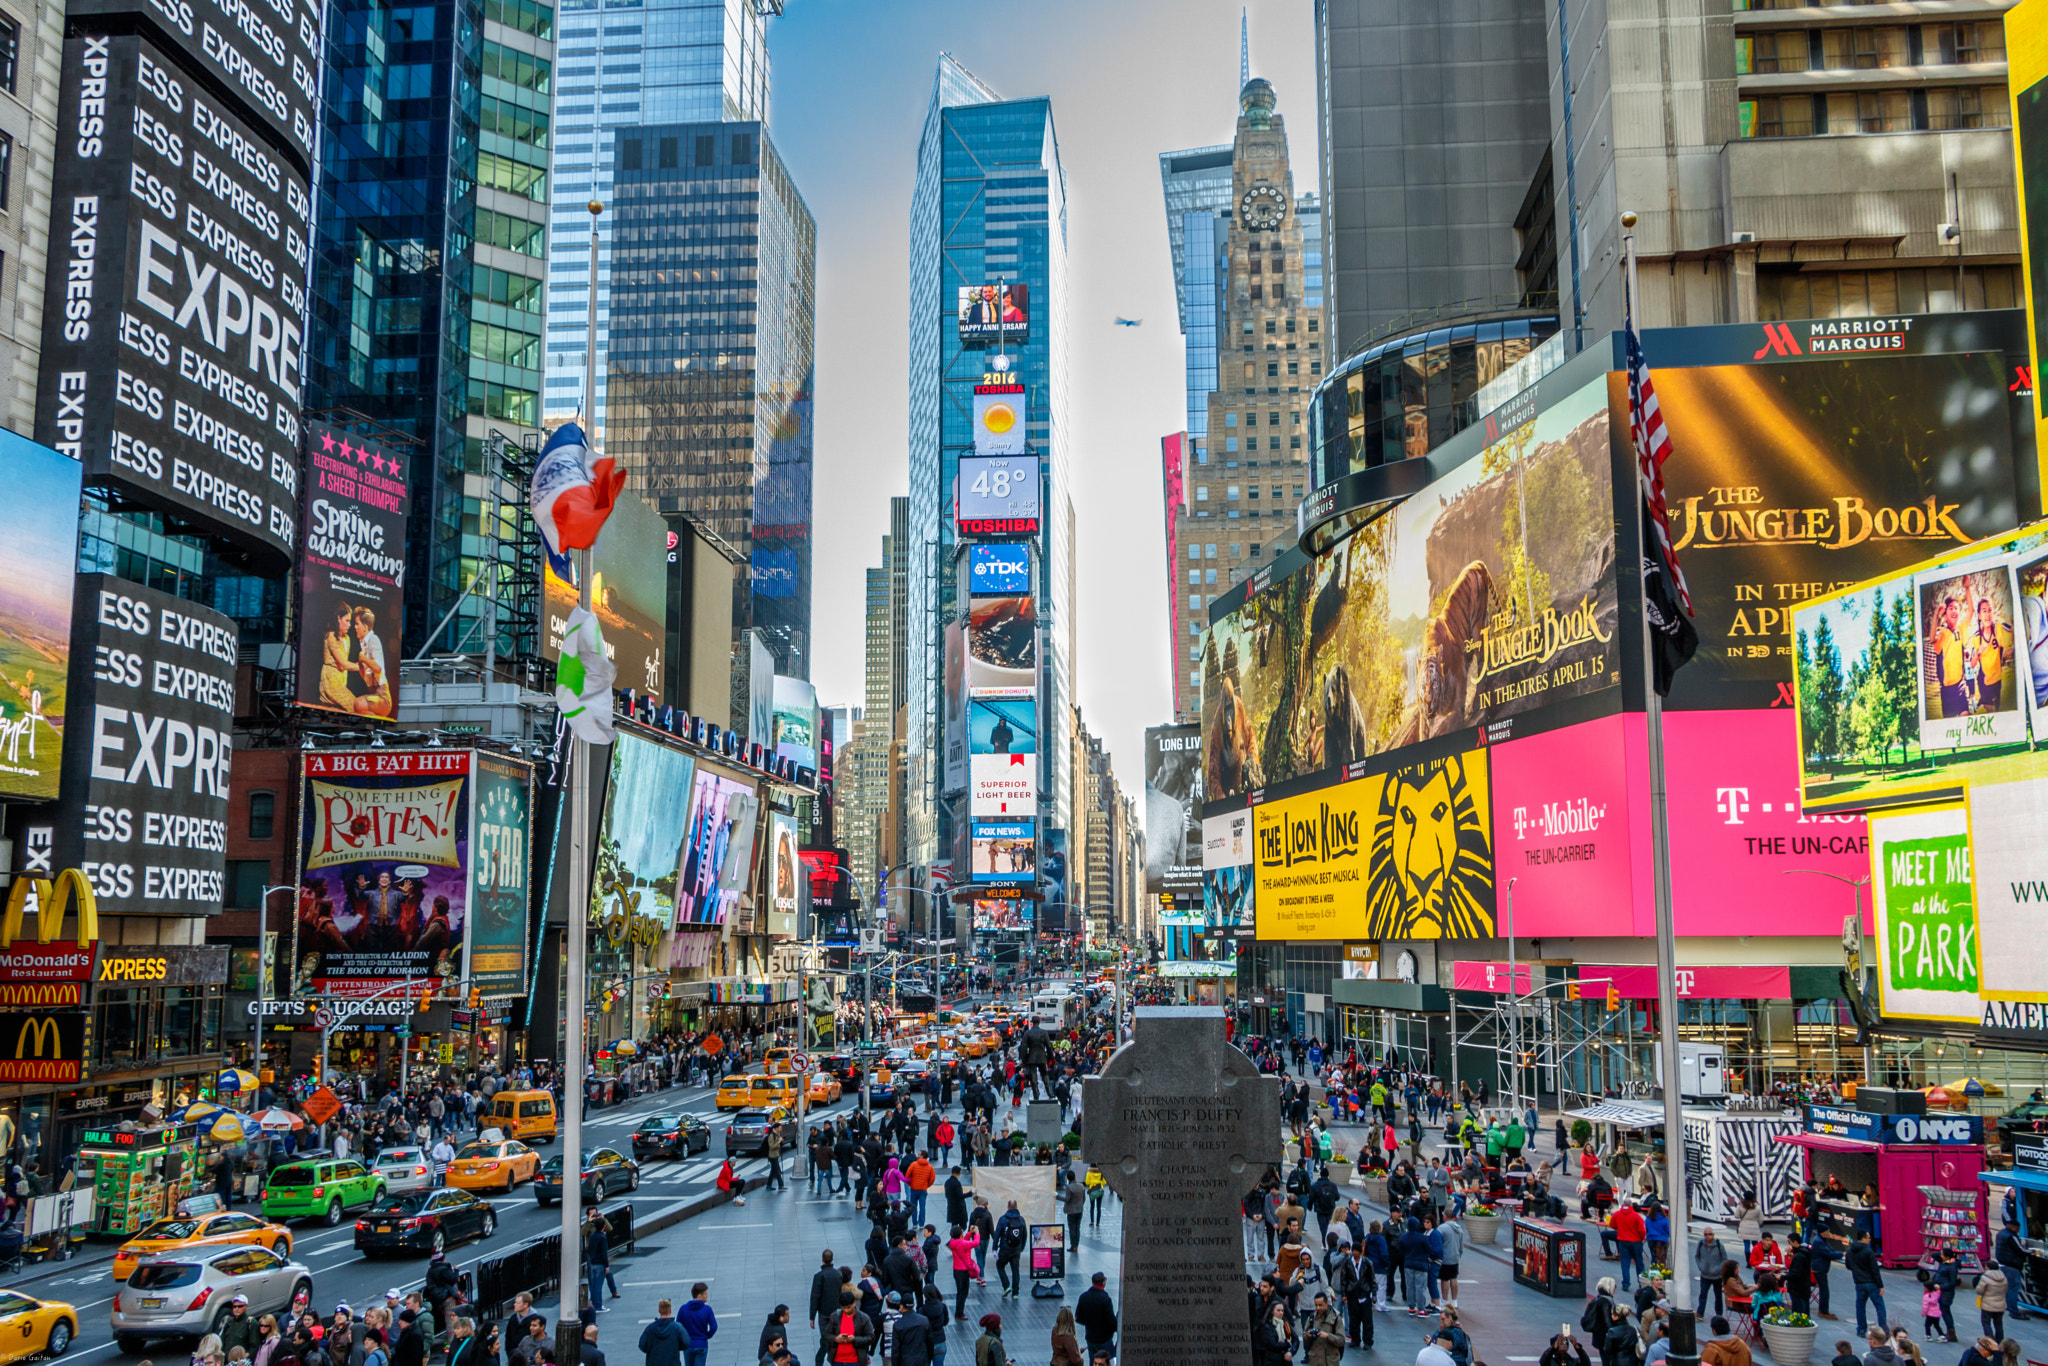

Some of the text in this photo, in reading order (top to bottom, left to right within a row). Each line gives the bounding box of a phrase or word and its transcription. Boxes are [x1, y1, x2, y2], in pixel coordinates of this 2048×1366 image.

[202, 21, 288, 121] EXPRESS
[137, 53, 280, 193] ESS EXPRESS
[63, 36, 109, 342] XPRESS EXPRESS
[191, 150, 281, 241] EXPRESS
[130, 162, 275, 290] ESS EXPRESS
[960, 322, 1028, 332] HAPPY ANNIERSARY
[1811, 318, 1913, 336] MARRIOTT
[1811, 335, 1902, 352] MARQUIS
[179, 345, 269, 422] EXPRESS
[983, 372, 1016, 385] 2016
[974, 385, 1025, 395] TOSHIBA
[1501, 386, 1539, 418] MARRIOTT
[116, 369, 264, 472] ESS EXPRESS
[1501, 402, 1536, 433] MARQUIS
[988, 442, 1012, 450] Sunny
[989, 459, 1010, 467] Now
[172, 457, 263, 526] EXPRESS
[319, 470, 326, 489] A
[327, 474, 355, 499] SHEER
[970, 469, 1027, 498] 48°
[1708, 486, 1764, 506] THE
[960, 518, 1039, 533] TOSHIBA
[1673, 494, 1988, 552] JUNGLE BOOK
[308, 533, 405, 587] awakening
[986, 562, 1024, 574] TDK
[98, 590, 237, 667] ESS EXPRESS
[1492, 610, 1513, 633] THE
[1470, 593, 1612, 685] JUNGLE BOOK
[1479, 692, 1491, 710] IN
[1495, 673, 1549, 705] THEATRES
[1553, 660, 1587, 688] APRIL
[1592, 654, 1605, 676] 15
[1488, 719, 1513, 733] MARRIOTT
[1160, 736, 1203, 752] LONG LIV
[1488, 729, 1512, 743] MARQUIS
[1945, 726, 1962, 747] my
[90, 703, 232, 800] EXPRE
[333, 757, 370, 772] BIG,
[377, 756, 412, 770] FAT
[333, 787, 441, 803] SOMETHING
[480, 786, 524, 823] BRIGHT
[143, 811, 225, 853] EXPRESS
[978, 827, 1022, 836] FOX NEWS
[1259, 827, 1281, 859] THE
[1284, 811, 1318, 868] LION
[1320, 802, 1359, 863] KING
[405, 851, 419, 859] NEW
[478, 822, 522, 888] STAR
[1525, 843, 1597, 866] THE UN-CARRIER
[1744, 837, 1786, 855] THE
[1891, 847, 1971, 888] MEET ME
[144, 866, 223, 903] EXPRESS
[1262, 868, 1360, 890] THE AWARD-WINNING BEST MUSICAL
[985, 888, 1021, 898] WELCOMES
[1912, 892, 1950, 915] at the
[0, 953, 90, 967] McDonald's
[389, 951, 430, 959] ALADDIN
[1898, 920, 1977, 982] PARK
[11, 969, 73, 977] Restaurant
[100, 958, 167, 981] XPRESS
[327, 967, 429, 975] THE BOOK OF MORMON
[818, 1023, 834, 1036] ALONG
[76, 1096, 108, 1109] EXPRESS
[1130, 1096, 1233, 1105] LIEUTENANT COLONEL
[1123, 1109, 1179, 1121] FRANCIS
[1196, 1109, 1243, 1121] DUFFY
[1812, 1108, 1872, 1126] The Official Guide
[1813, 1122, 1848, 1134] nycgo.com
[1919, 1120, 1971, 1140] NYC
[84, 1131, 112, 1144] HALAL
[1139, 1141, 1227, 1150] CATHOLIC PRIEST
[1160, 1165, 1207, 1174] CHAPLAIN
[1151, 1217, 1170, 1226] LIFE
[1174, 1217, 1187, 1226] OF
[1191, 1217, 1230, 1226] SERVICE
[1137, 1237, 1233, 1246] GOD AND COUNTRY
[1171, 1262, 1214, 1270] AMERICAN
[1216, 1262, 1235, 1270] WAR
[1125, 1274, 1246, 1282] NEW YORK NATIONAL GUARD
[1148, 1286, 1223, 1294] MEXICAN BORDER
[1157, 1298, 1214, 1306] WORLD WAR
